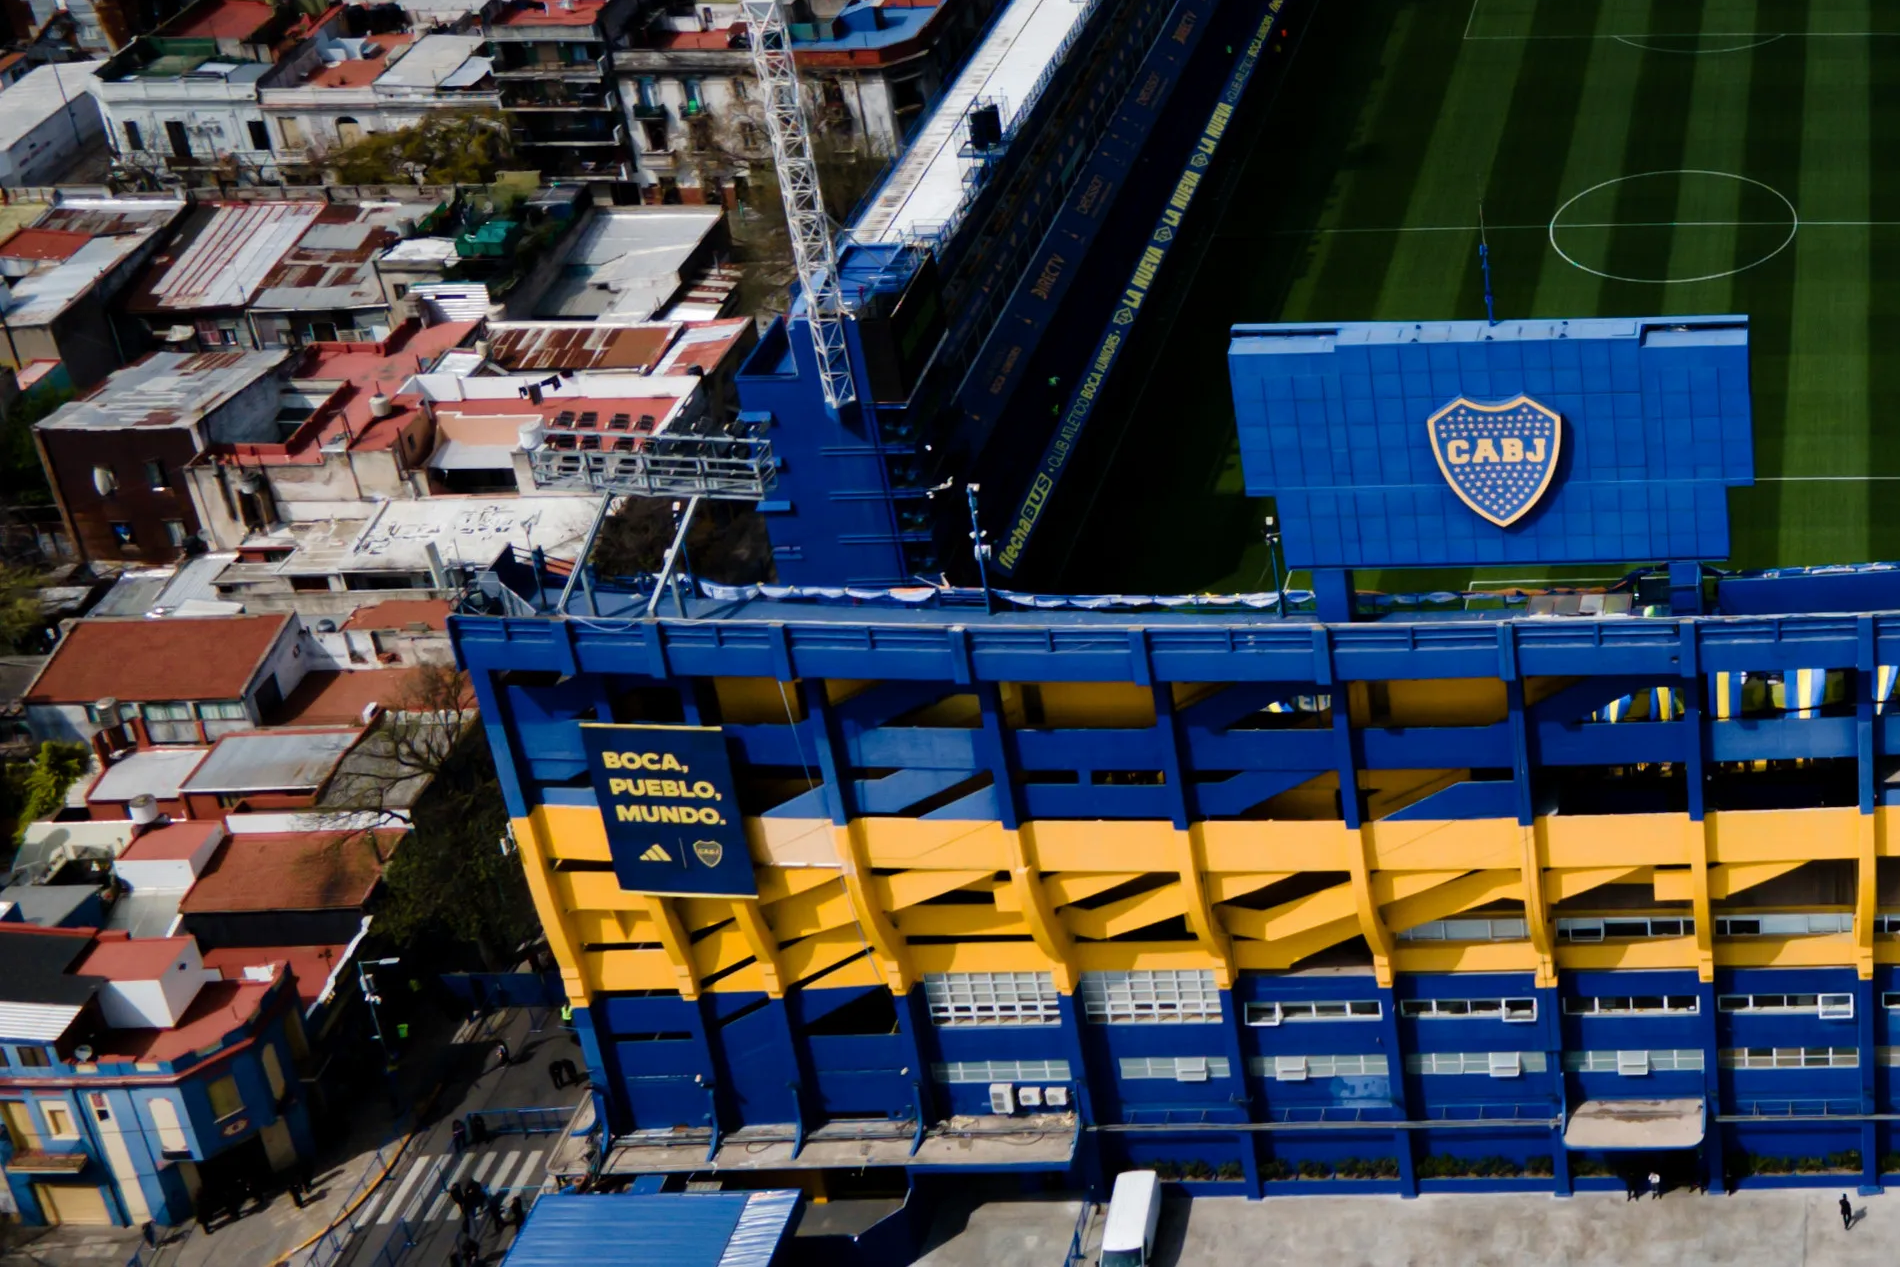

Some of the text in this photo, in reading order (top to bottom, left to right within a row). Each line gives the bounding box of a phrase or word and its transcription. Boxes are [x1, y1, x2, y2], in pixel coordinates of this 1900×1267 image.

[1205, 102, 1233, 139] NUEVA
[1198, 137, 1216, 154] LA
[1171, 170, 1200, 209] NUEVA
[1162, 207, 1181, 227] LA
[1132, 246, 1165, 290] NUEVA
[1122, 288, 1144, 309] LA
[1047, 439, 1068, 465] CLUB
[1079, 373, 1103, 399] BOCA
[1094, 333, 1120, 372] JUNIORS
[1447, 438, 1547, 464] CABJ
[602, 751, 689, 774] BOCA,
[609, 778, 723, 802] PUEBLO,
[615, 805, 727, 826] MUNDO.
